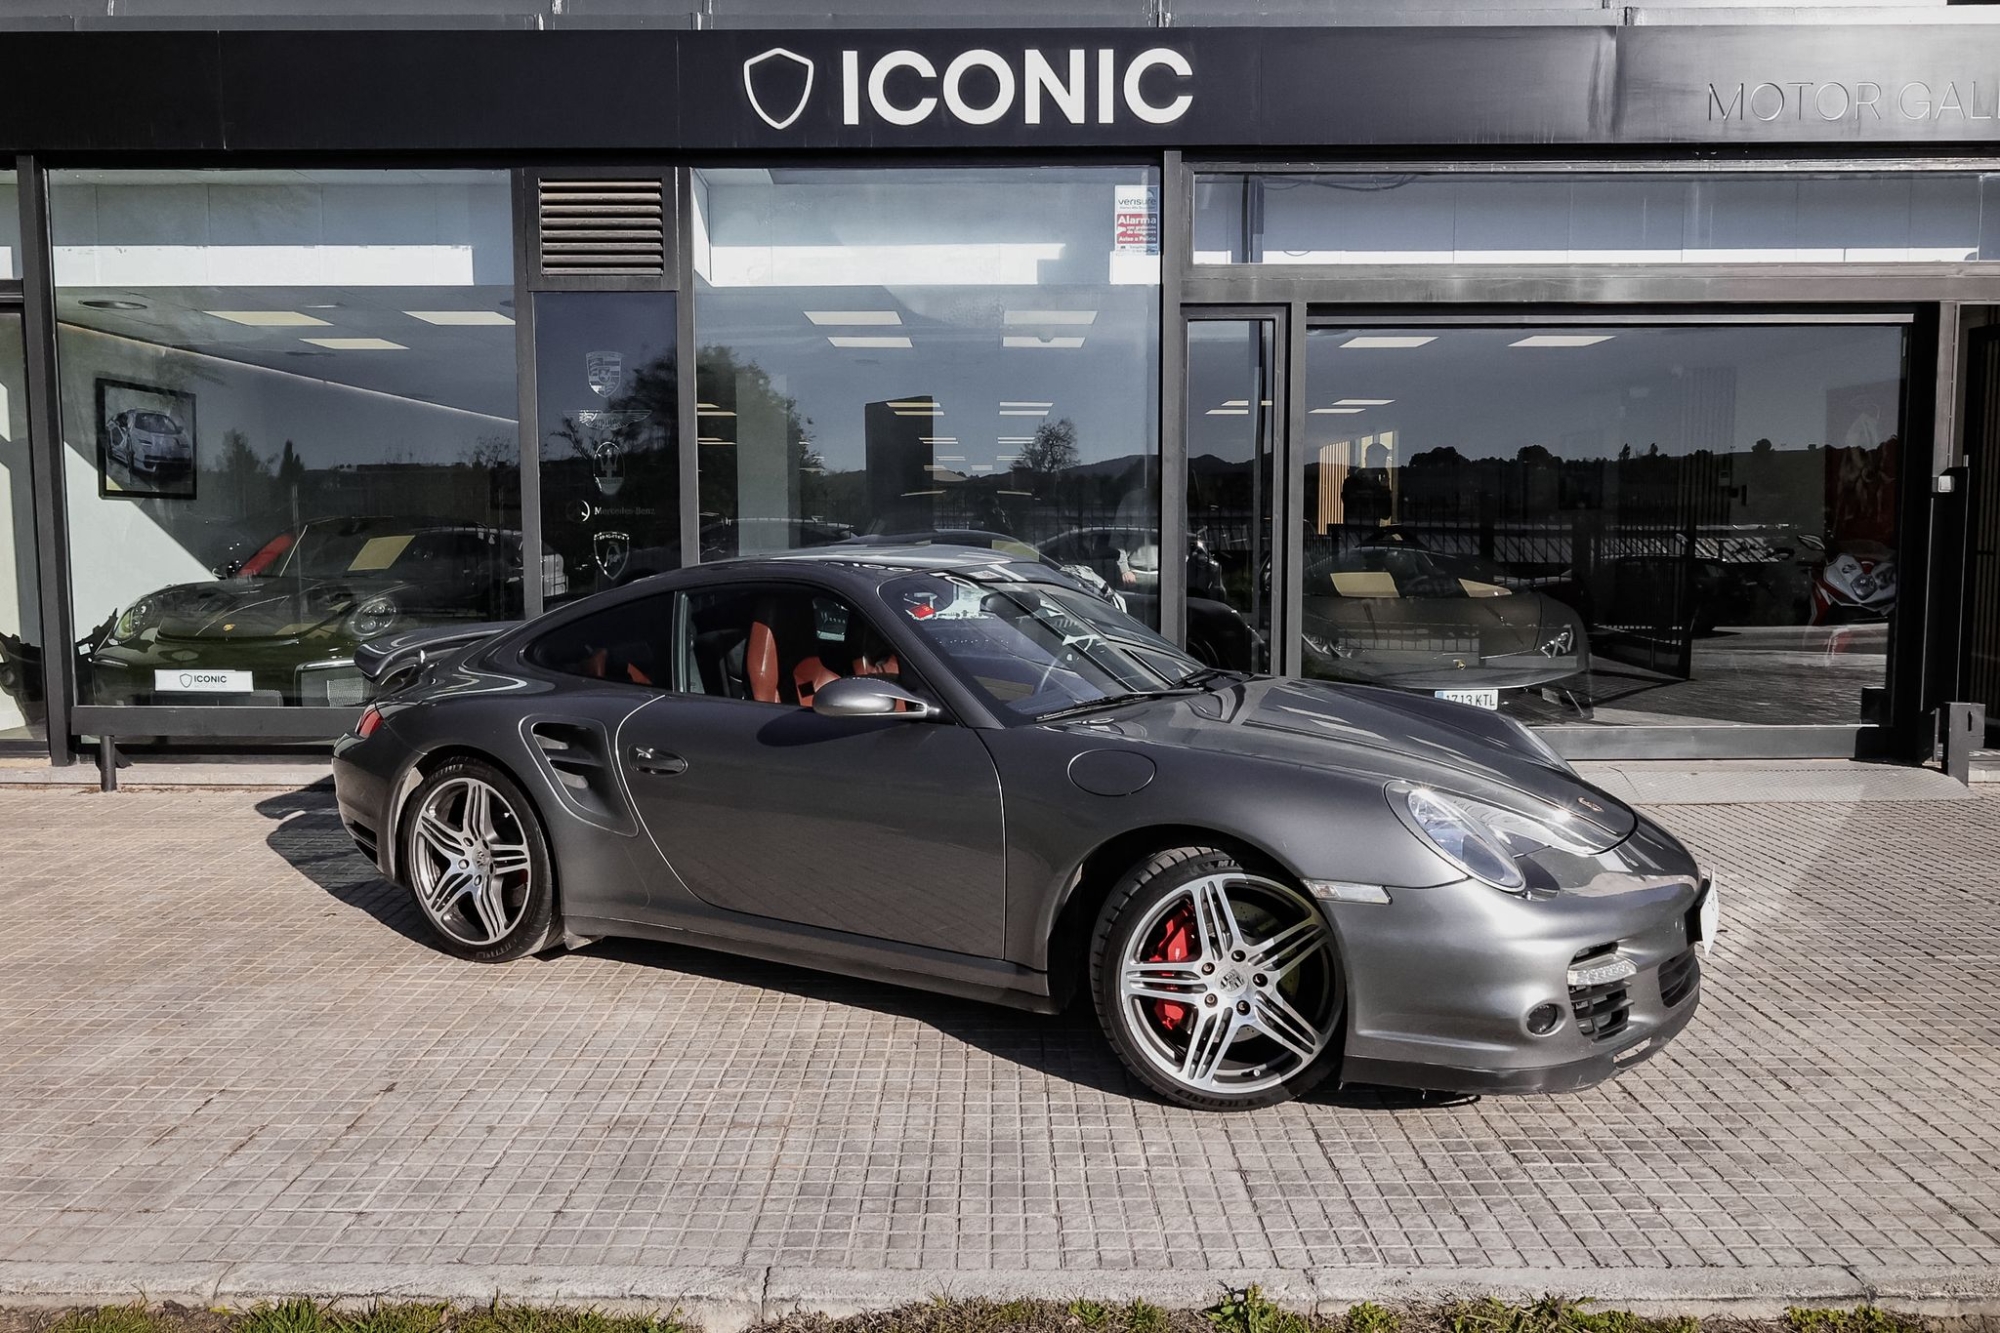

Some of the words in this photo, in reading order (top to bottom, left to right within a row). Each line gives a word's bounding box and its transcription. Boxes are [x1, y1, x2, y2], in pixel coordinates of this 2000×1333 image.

[842, 48, 1194, 126] ICONIC
[1708, 82, 1881, 121] MOTOR
[1898, 82, 2000, 121] GAL
[1117, 215, 1157, 225] Alarma
[194, 675, 227, 683] ICONIC
[1475, 694, 1496, 706] KTL
